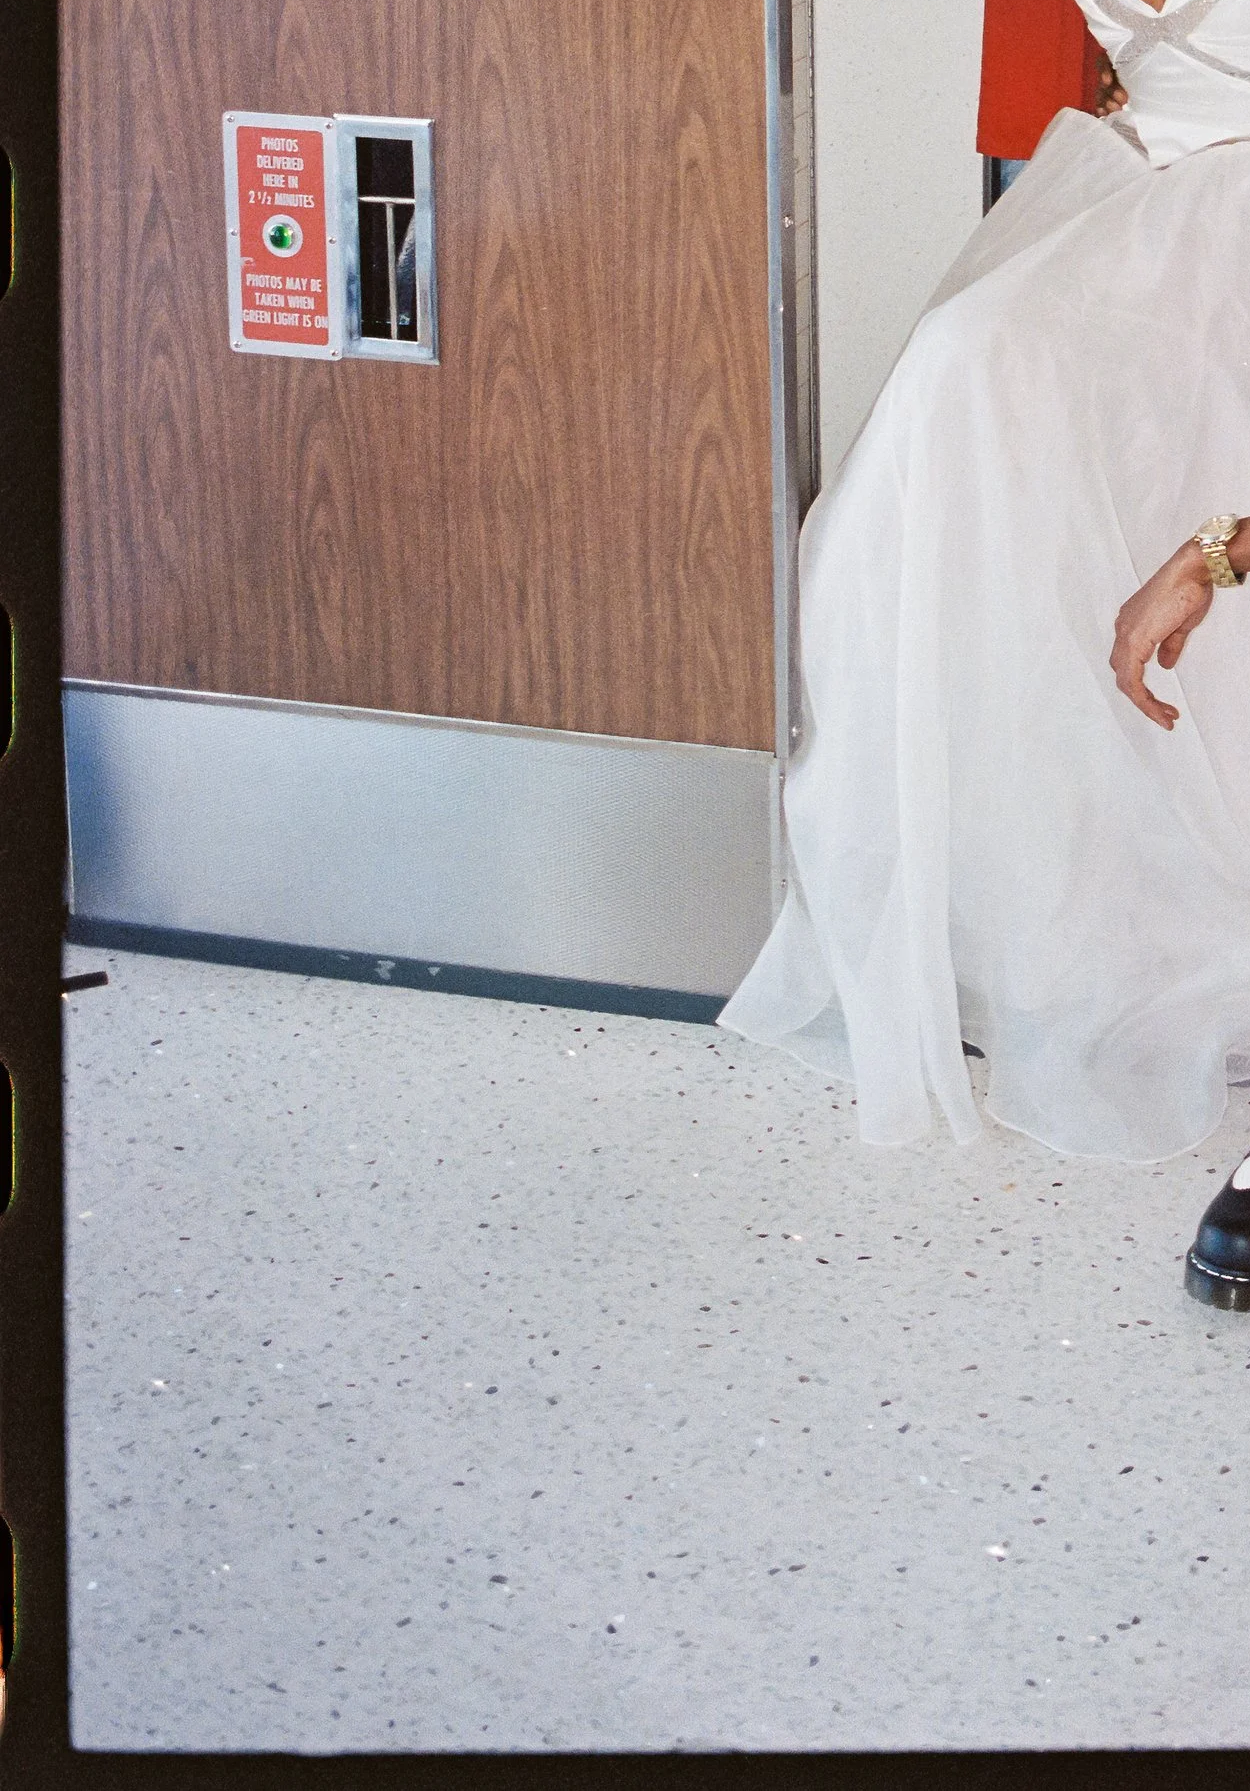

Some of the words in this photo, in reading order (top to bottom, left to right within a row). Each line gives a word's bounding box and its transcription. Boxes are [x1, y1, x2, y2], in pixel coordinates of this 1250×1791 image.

[261, 137, 299, 152] PHOTOS
[256, 155, 304, 171] DELIVERED
[262, 173, 285, 188] HERE
[287, 175, 299, 189] IN
[274, 192, 315, 208] MINUTES
[246, 273, 283, 289] PHOTOS
[285, 277, 308, 291] MAY
[310, 279, 322, 293] BE
[254, 292, 285, 307] TAKEN
[287, 295, 315, 310] WHEN
[243, 309, 271, 324] GREEN
[273, 311, 300, 326] LIGHT
[302, 314, 312, 328] IS
[314, 315, 329, 329] ON
